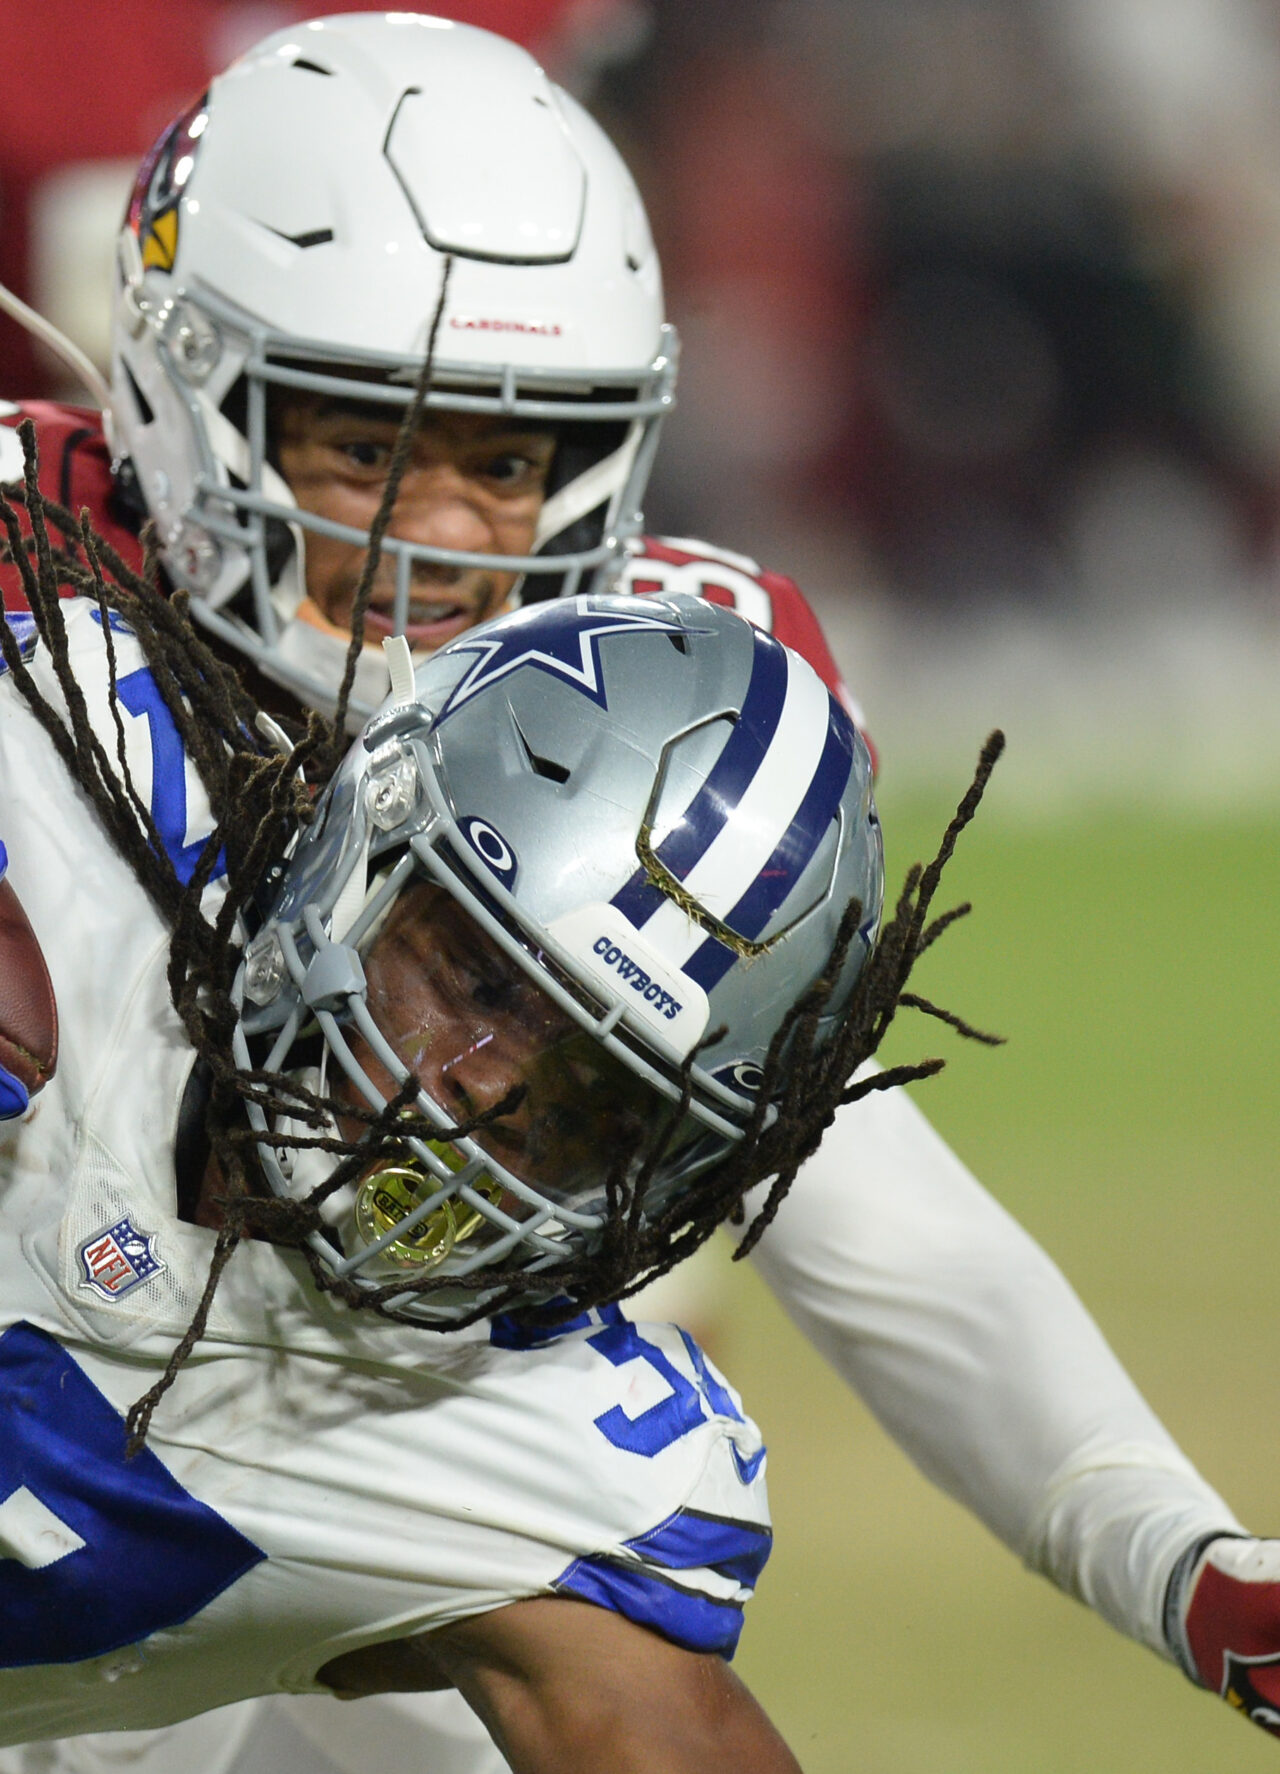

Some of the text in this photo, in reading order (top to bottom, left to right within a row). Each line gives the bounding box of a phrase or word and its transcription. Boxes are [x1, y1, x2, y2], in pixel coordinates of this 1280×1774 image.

[450, 318, 561, 335] CARDINALS
[592, 935, 683, 1020] COWBOYS
[86, 1237, 132, 1291] NFL
